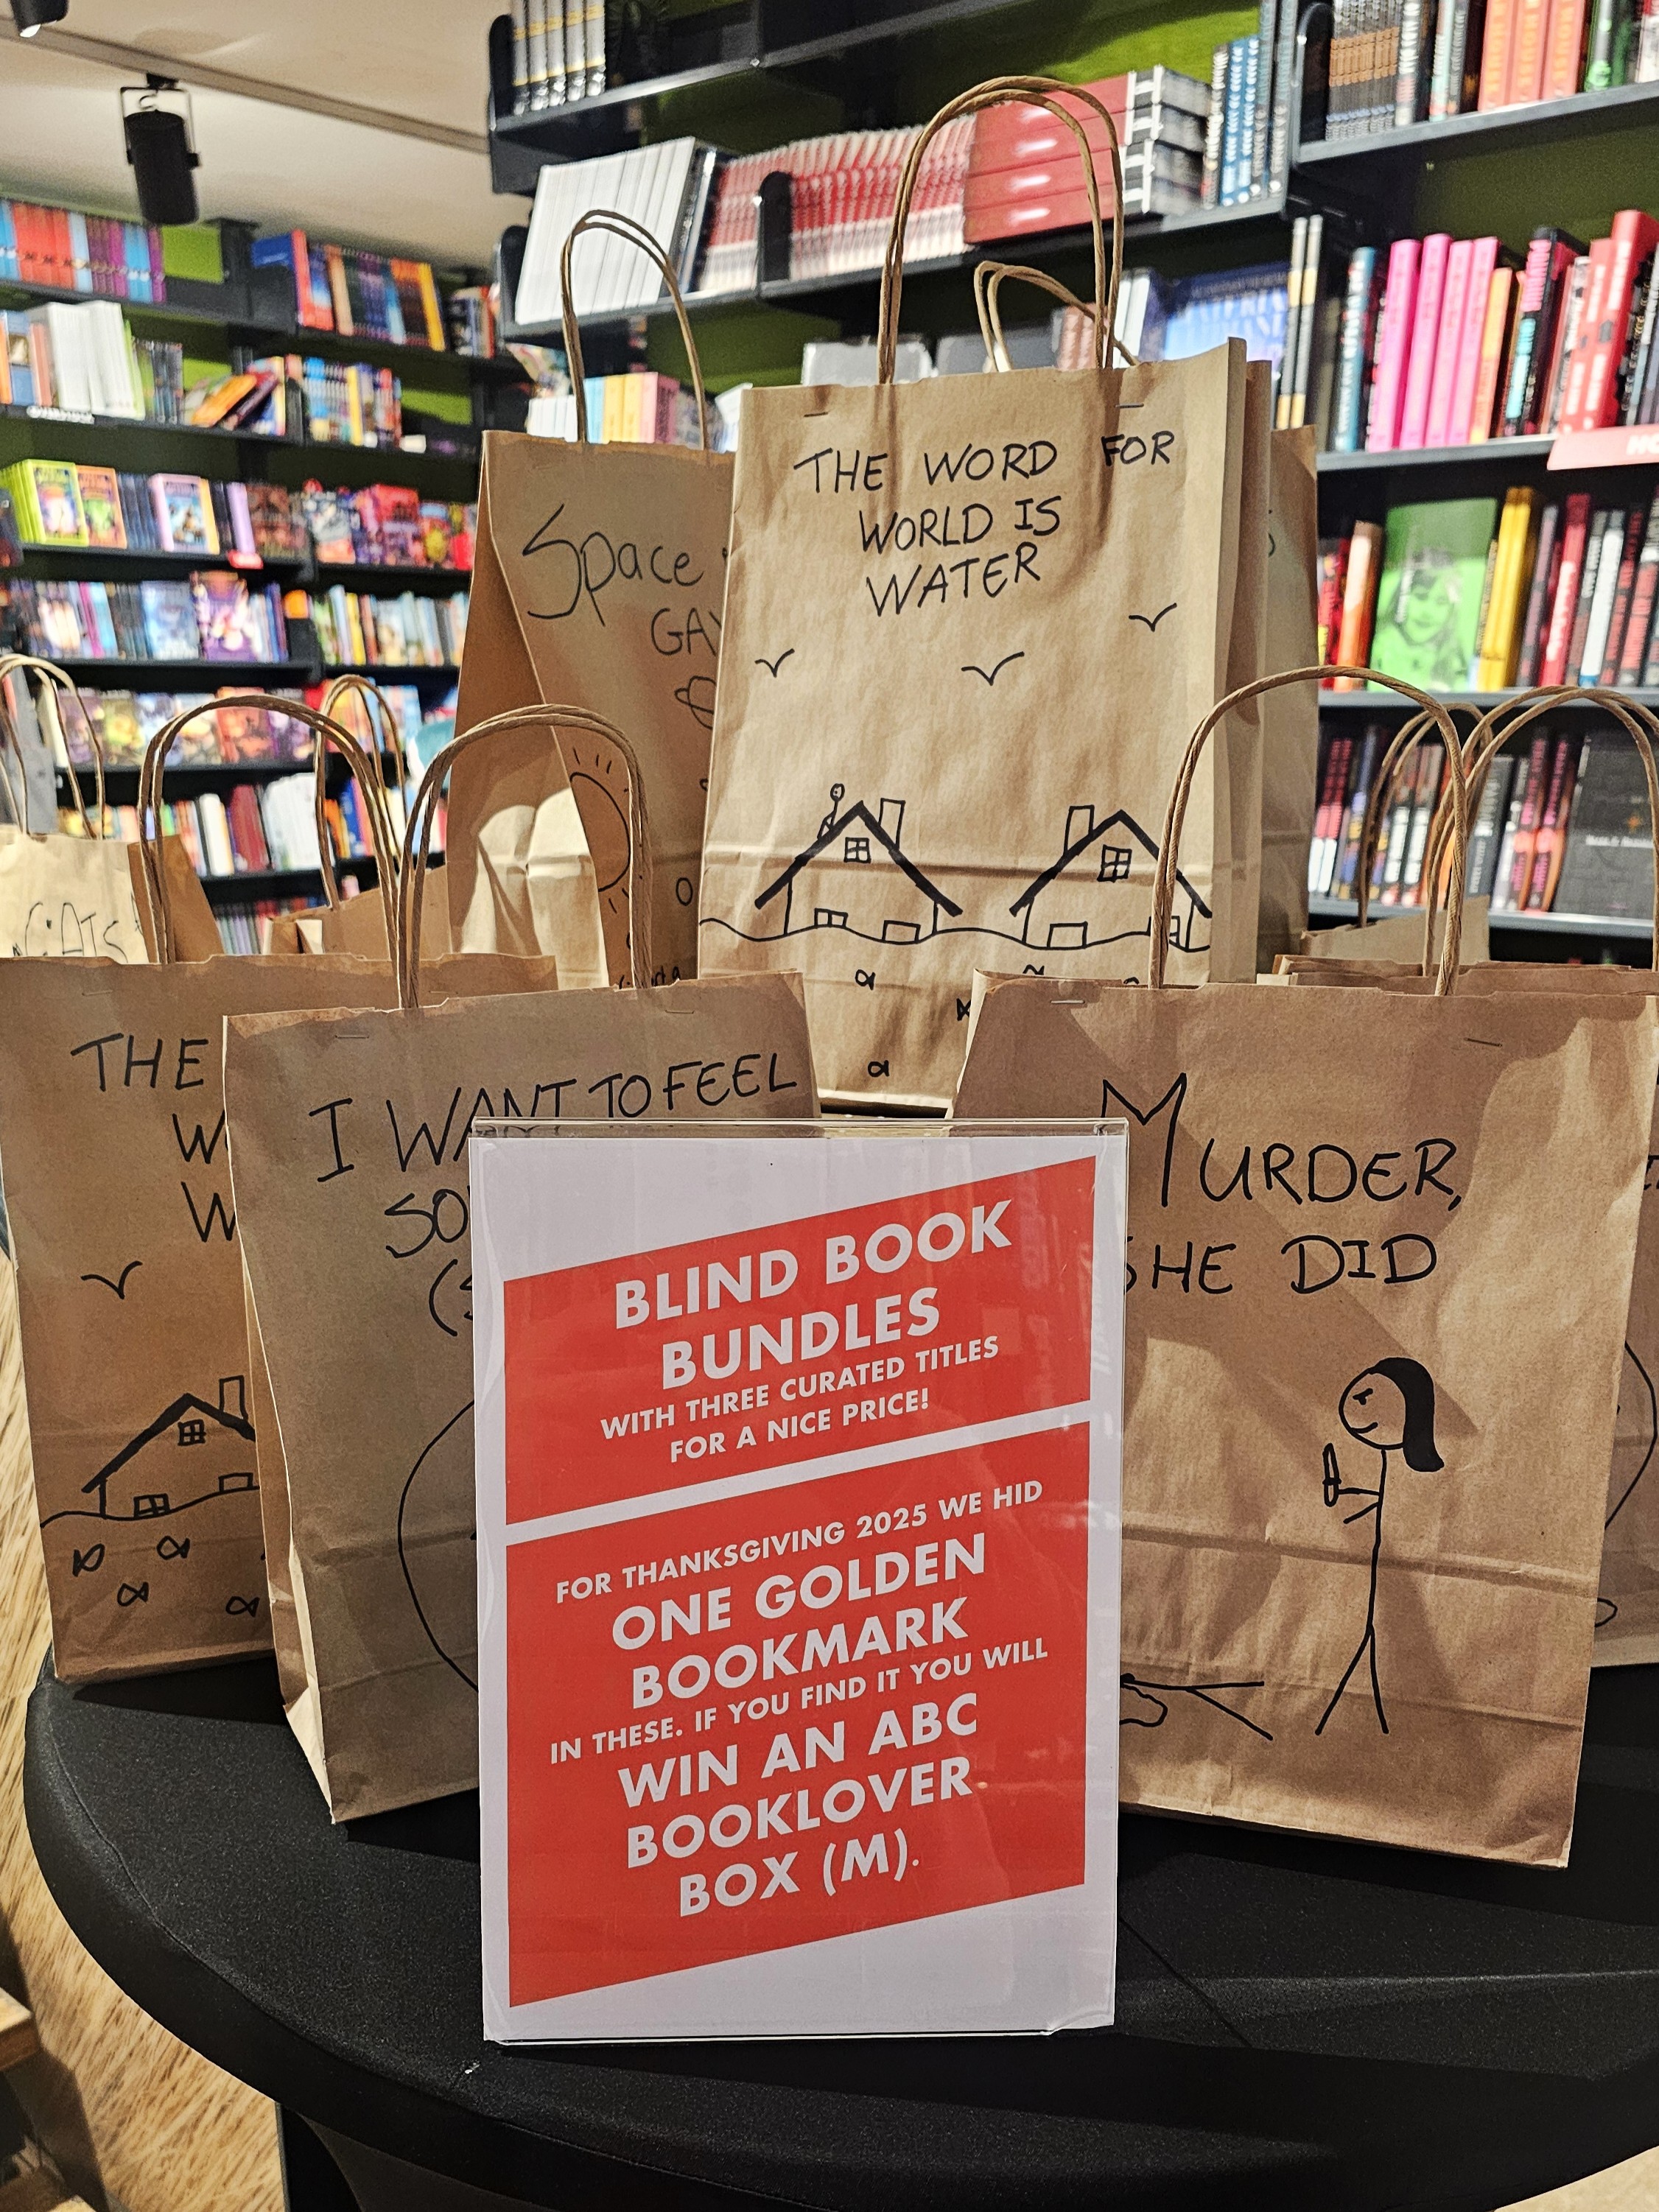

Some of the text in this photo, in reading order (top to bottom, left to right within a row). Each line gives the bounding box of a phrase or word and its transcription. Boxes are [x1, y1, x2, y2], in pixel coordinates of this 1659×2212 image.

[794, 430, 1175, 493] THE WORD FOR
[522, 503, 704, 627] Space
[859, 495, 1062, 554] WORLD IS
[866, 541, 1041, 617] WATER
[70, 1033, 208, 1092] THE
[309, 1098, 354, 1182] I
[588, 1072, 651, 1118] TO
[663, 1053, 798, 1111] FEEL
[616, 1200, 1011, 1329] BLIND BOOK
[1280, 1233, 1437, 1294] DID
[600, 1336, 998, 1439] WITH THREE CURATED TITLES
[662, 1288, 940, 1390] BUNDLES
[671, 1388, 928, 1462] FOR A NICE PRICE!
[558, 1481, 1042, 1603] FOR THANKSGIVING 2025 WE HID
[613, 1534, 985, 1649] ONE GOLDEN
[552, 1638, 1048, 1763] IN THESE. IF YOU FIND IT YOU WILL
[633, 1598, 968, 1708] BOOKMARK
[619, 1693, 976, 1808] WIN AN ABC
[628, 1757, 973, 1867] BOOKLOVER
[681, 1828, 919, 1917] BOX (M).
